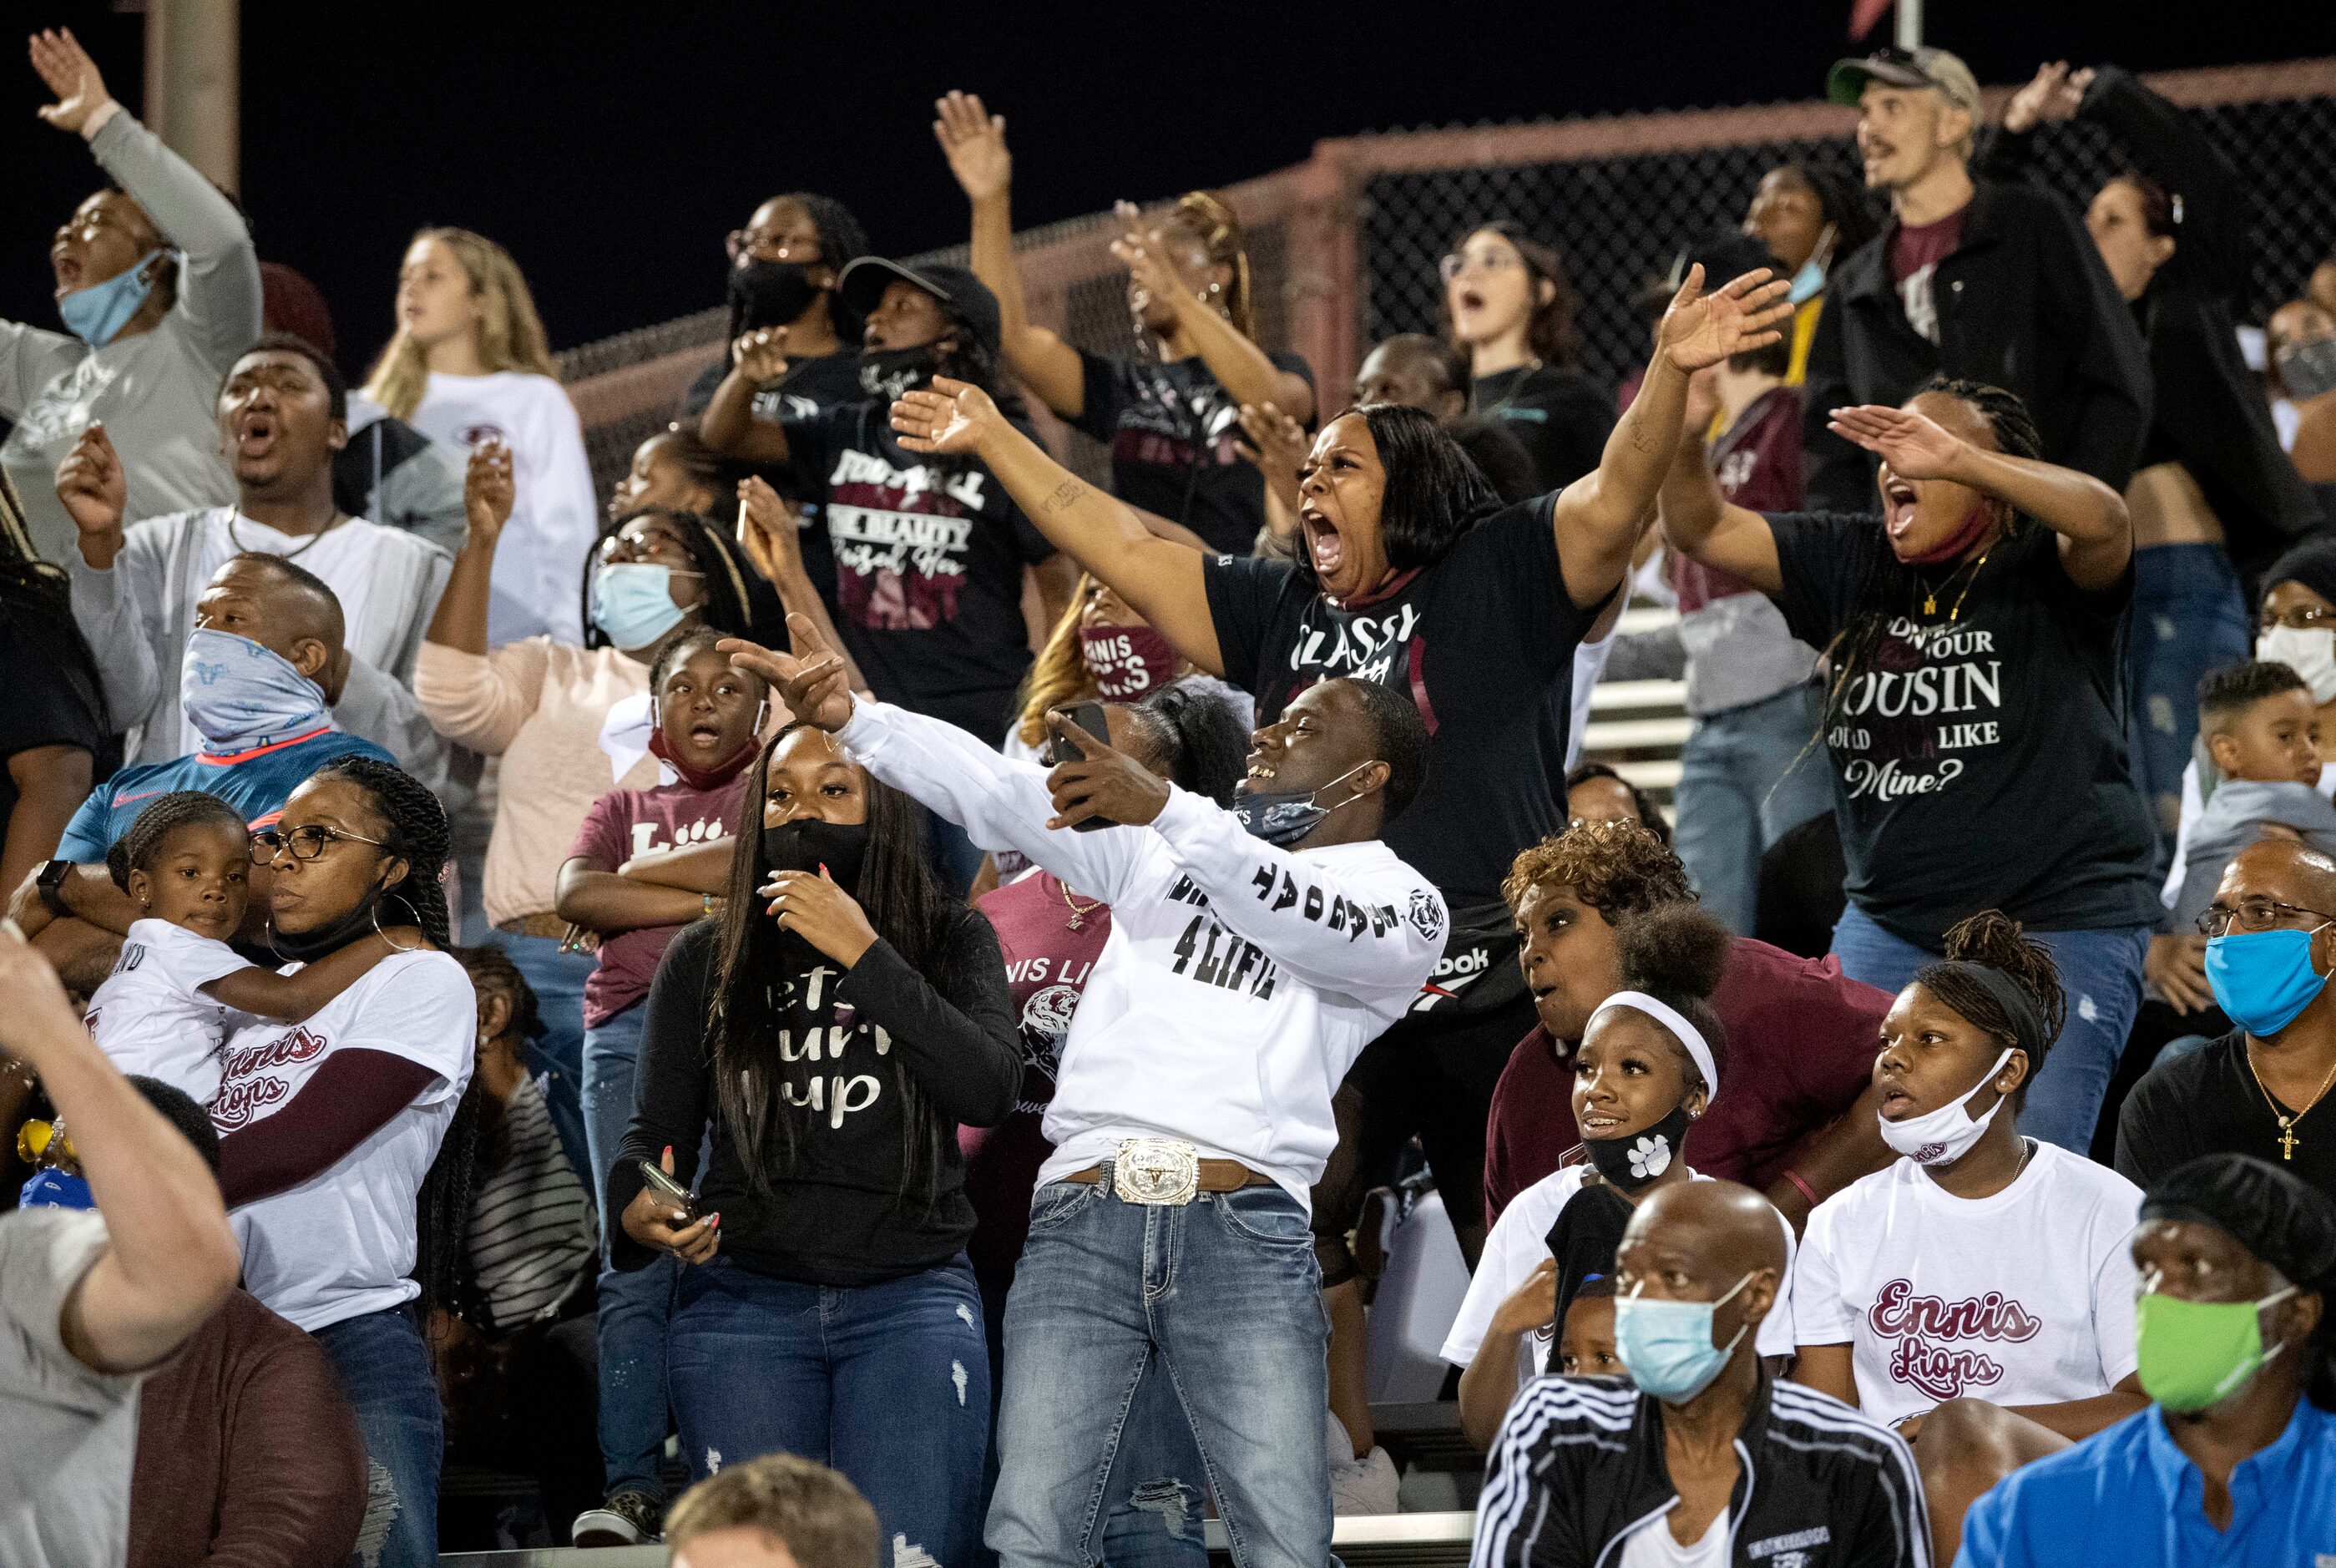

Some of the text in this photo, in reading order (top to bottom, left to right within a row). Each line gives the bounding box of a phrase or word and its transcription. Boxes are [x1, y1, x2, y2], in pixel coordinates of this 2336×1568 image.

[1835, 660, 2002, 718] OUSIN
[1938, 721, 2000, 749] LIKE
[1844, 758, 1964, 802] Mine?
[1868, 1278, 2042, 1343] Ennis
[1890, 1335, 2004, 1404] Lions
